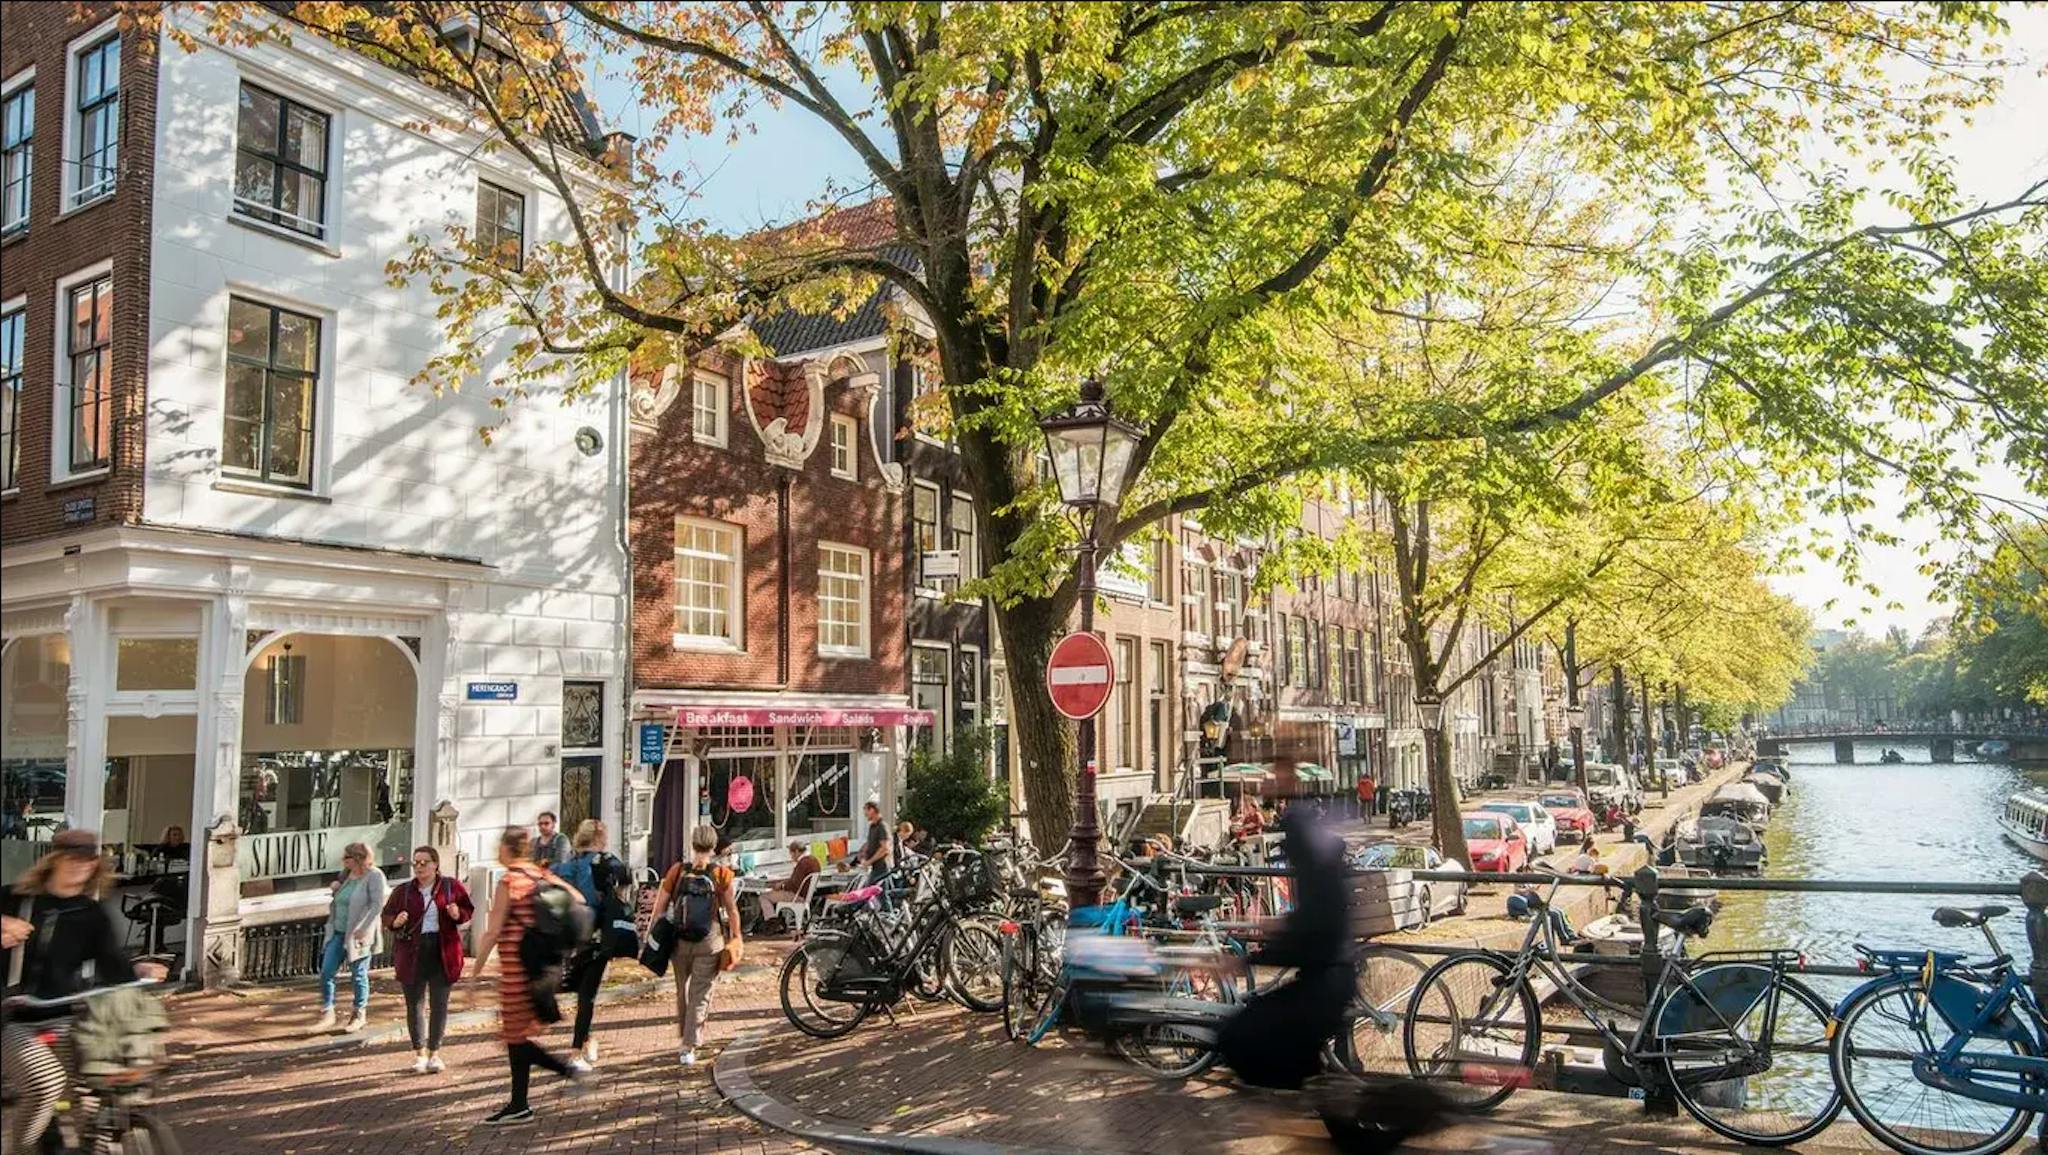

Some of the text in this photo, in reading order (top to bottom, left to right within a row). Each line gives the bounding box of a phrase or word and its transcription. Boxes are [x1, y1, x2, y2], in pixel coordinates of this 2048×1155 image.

[685, 711, 749, 724] Breakfast
[769, 712, 822, 724] Sandwich
[841, 713, 874, 724] Salads
[642, 752, 661, 760] To Go
[250, 833, 327, 877] SIMONE
